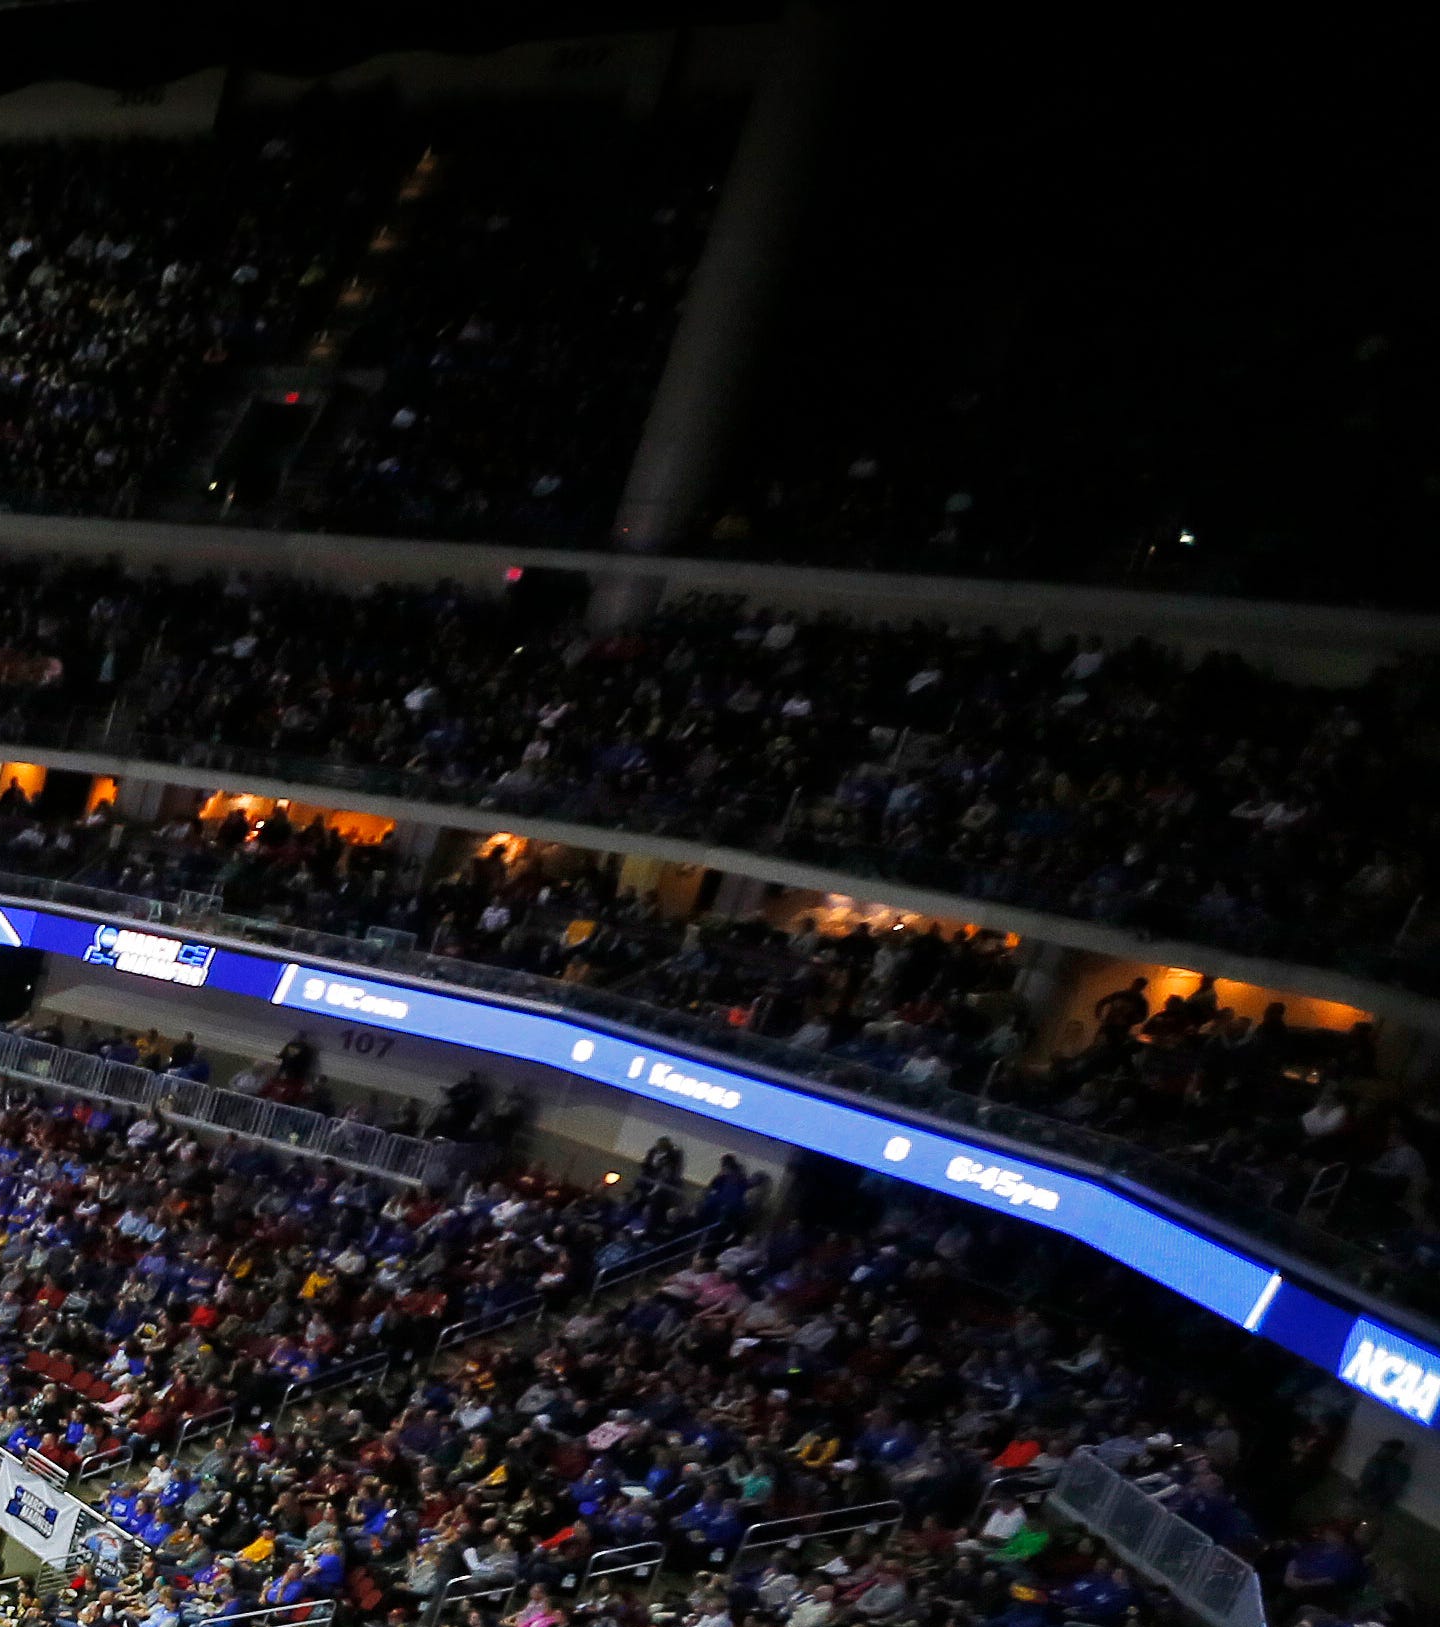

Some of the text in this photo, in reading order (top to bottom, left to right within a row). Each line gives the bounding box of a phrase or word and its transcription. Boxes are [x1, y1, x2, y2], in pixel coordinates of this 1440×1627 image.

[341, 1029, 395, 1058] 107
[946, 1156, 1060, 1211] 6:45pm
[1345, 1339, 1440, 1427] NCAA
